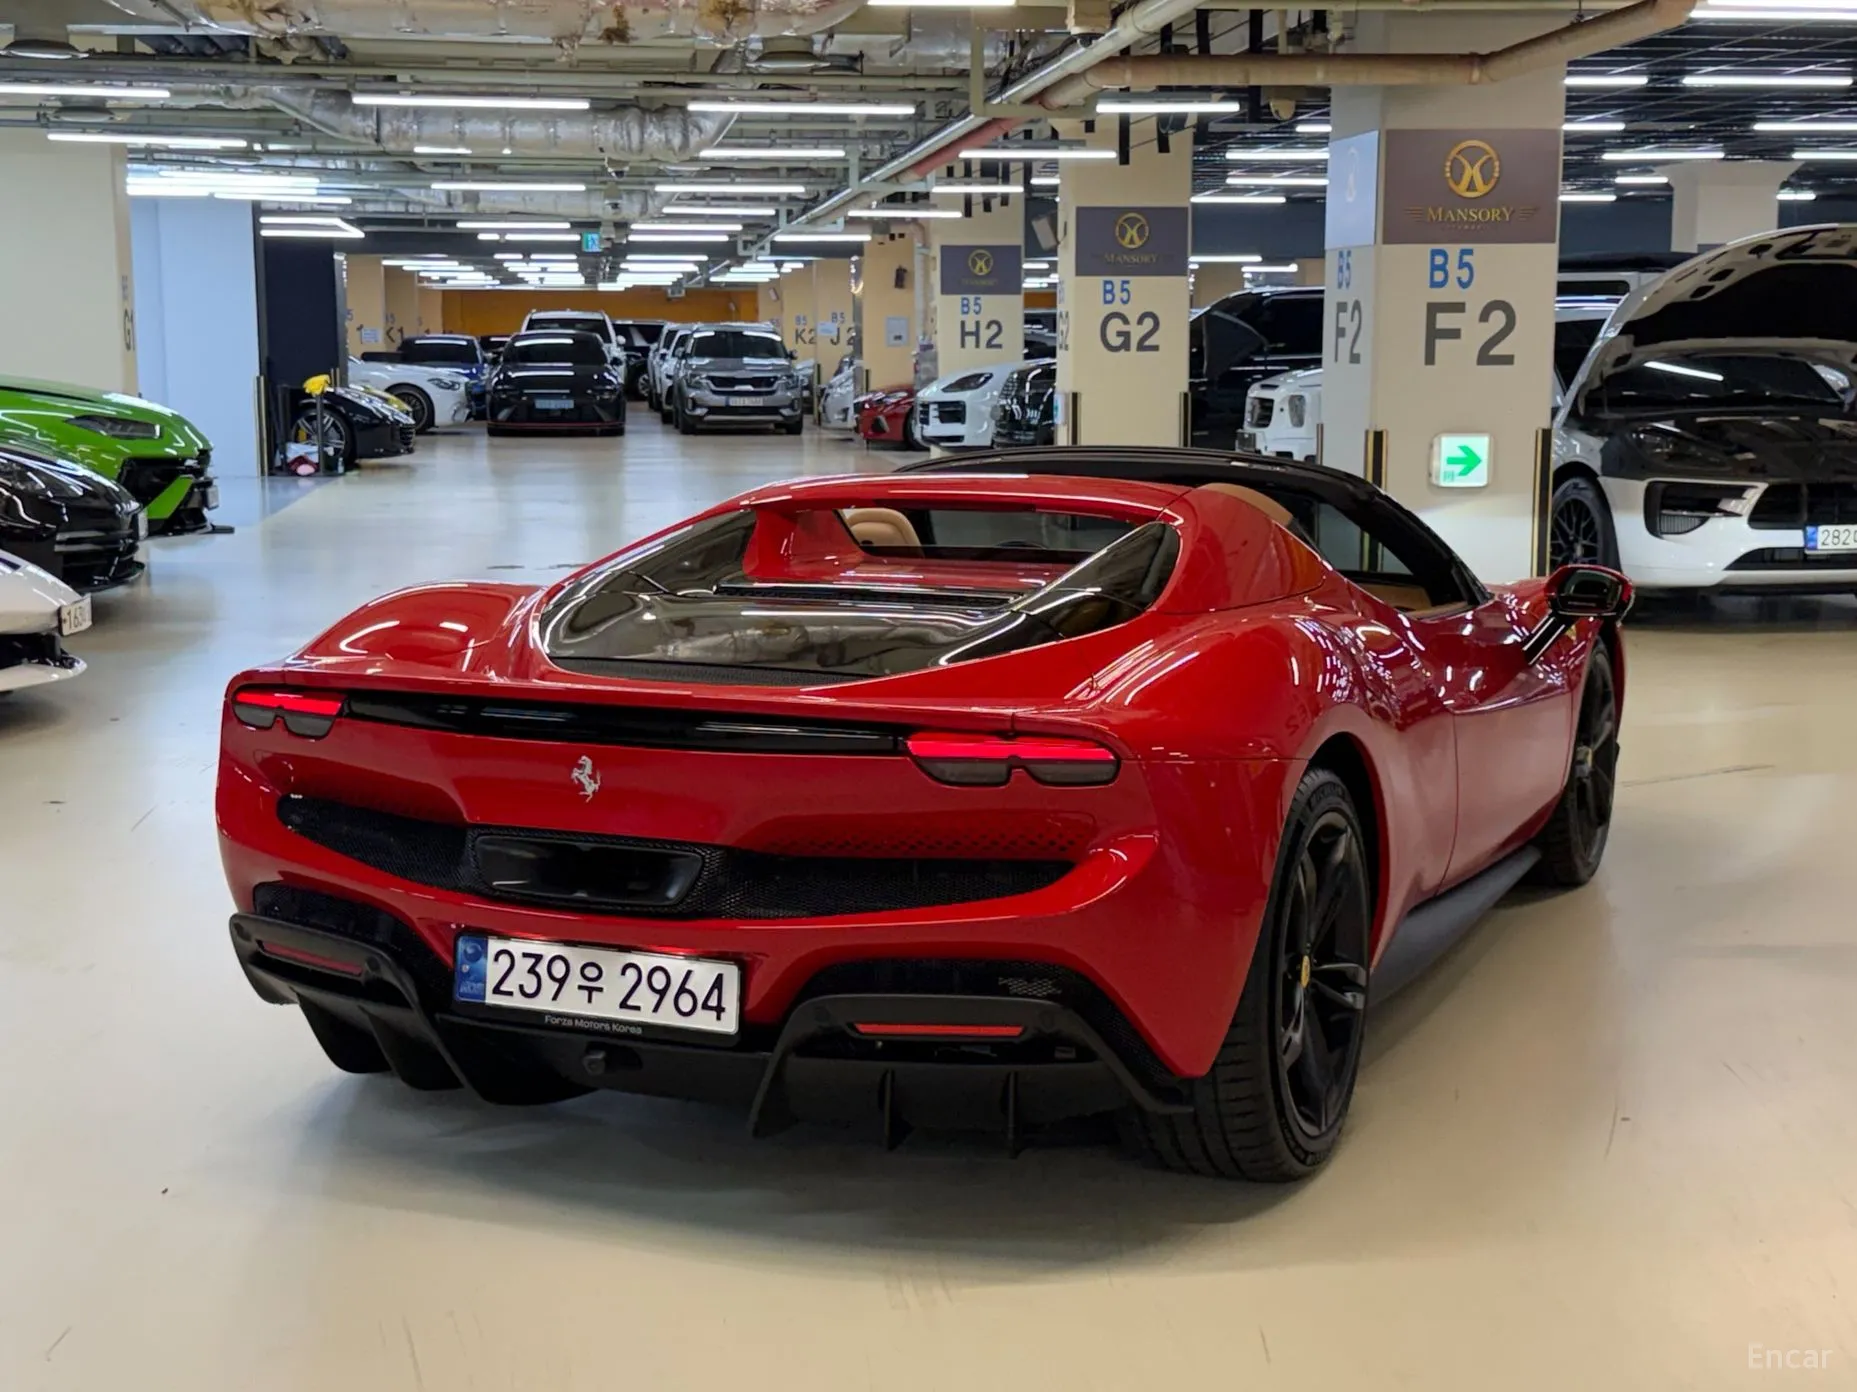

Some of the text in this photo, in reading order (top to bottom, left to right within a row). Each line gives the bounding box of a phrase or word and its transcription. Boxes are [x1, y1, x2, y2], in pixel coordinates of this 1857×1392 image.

[1427, 206, 1515, 222] MANSORY
[1104, 252, 1159, 265] MANSORY
[1338, 250, 1352, 289] B5
[1429, 248, 1474, 289] B5
[961, 296, 982, 315] B5
[1103, 280, 1131, 305] B5
[831, 312, 845, 324] B5
[795, 328, 816, 345] K2
[960, 319, 1003, 349] H2
[1100, 311, 1160, 353] G2
[1334, 299, 1362, 365] F2
[1424, 299, 1516, 366] F2
[492, 949, 726, 1021] 239우 2964
[544, 1014, 642, 1034] Forza Motors Korea
